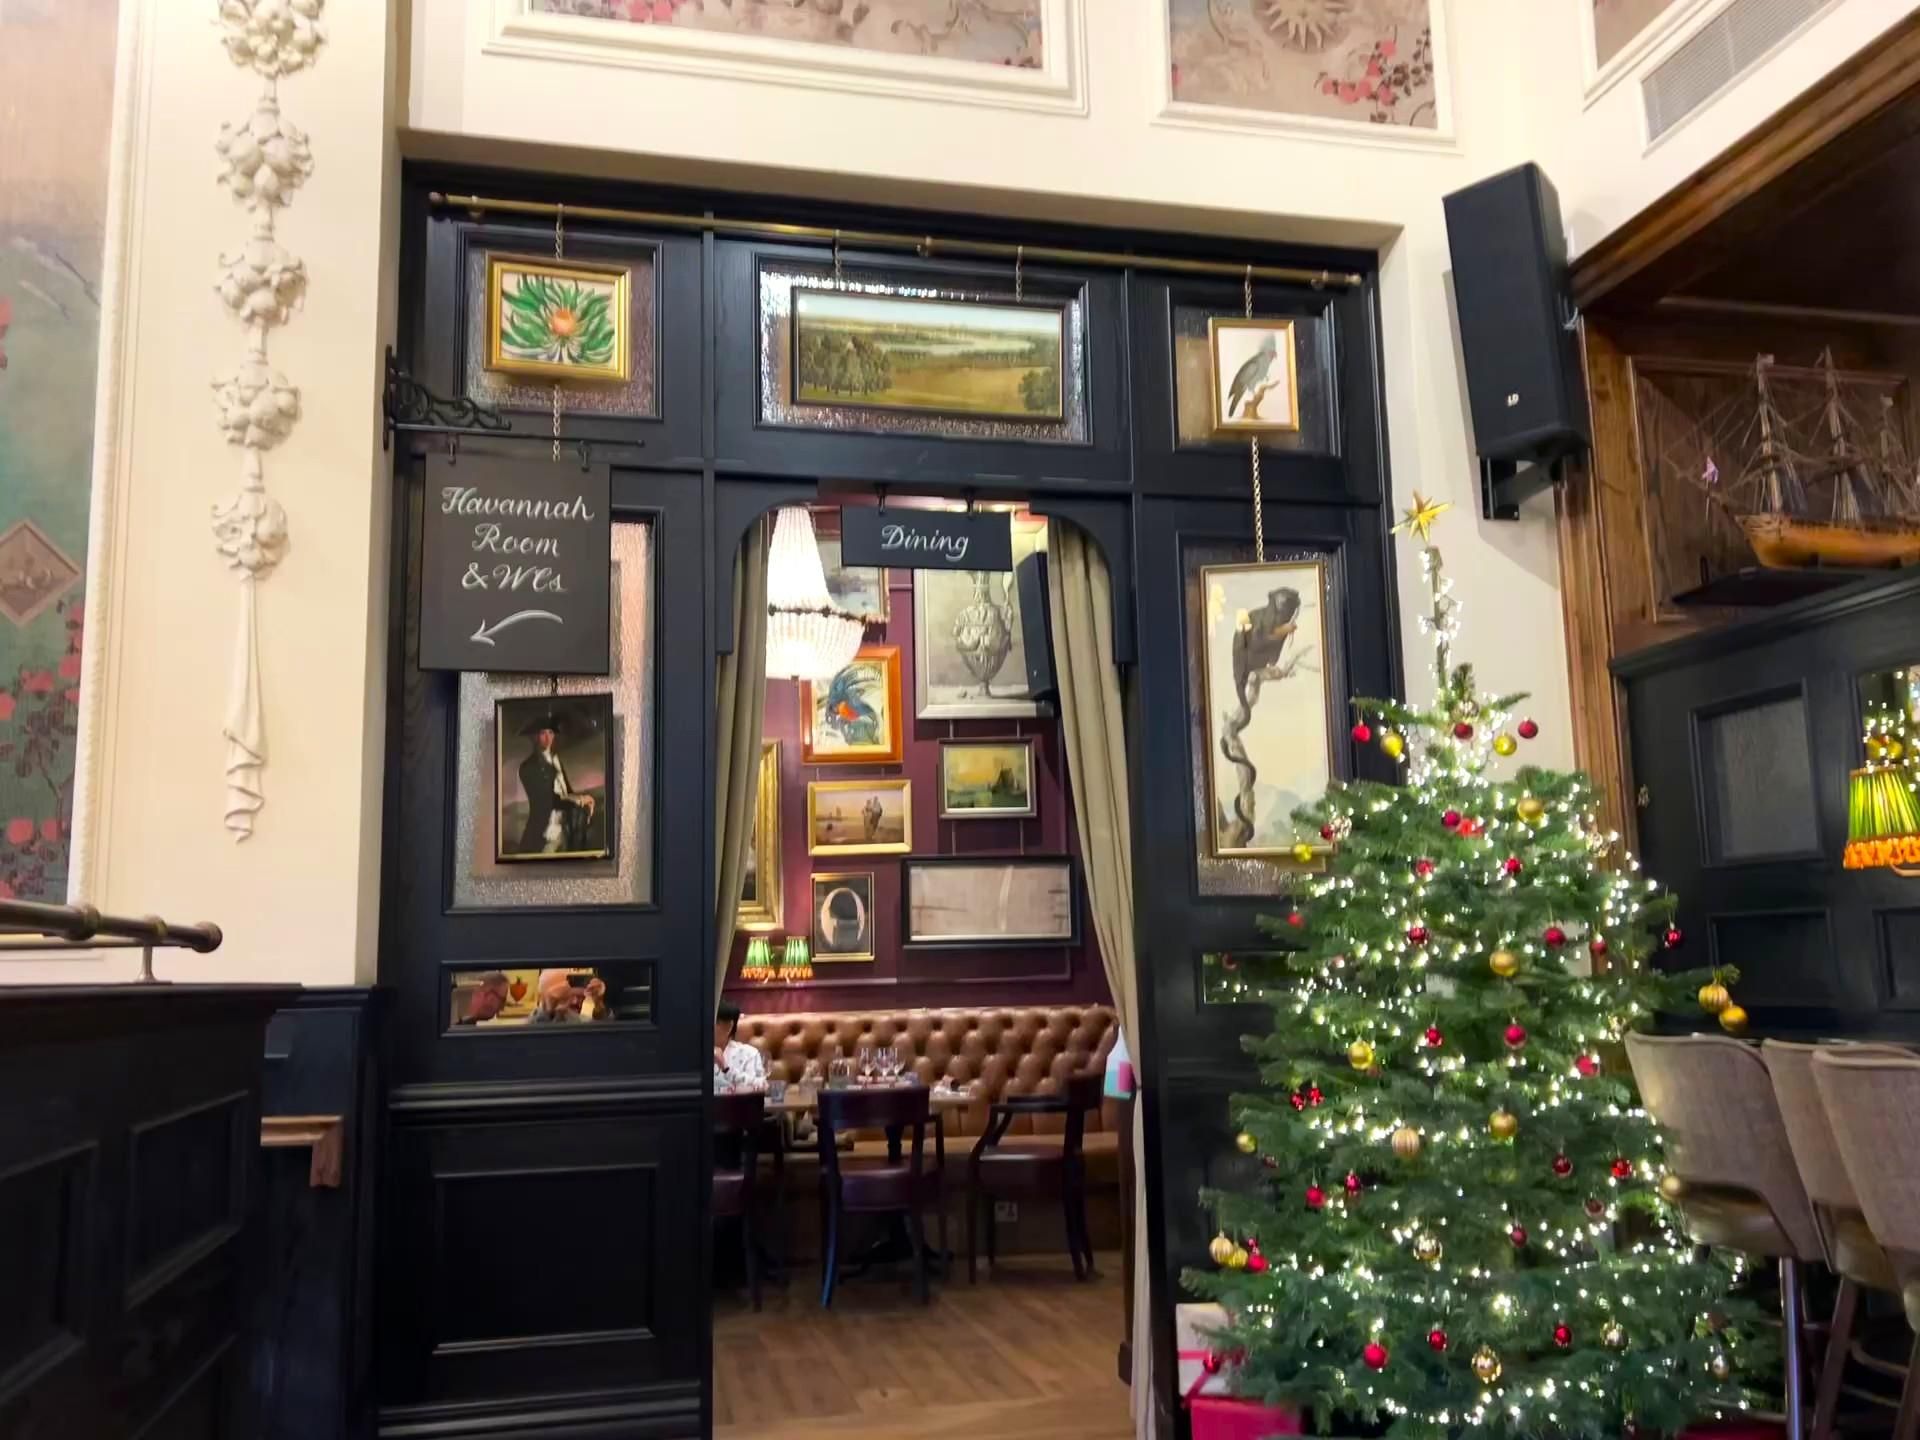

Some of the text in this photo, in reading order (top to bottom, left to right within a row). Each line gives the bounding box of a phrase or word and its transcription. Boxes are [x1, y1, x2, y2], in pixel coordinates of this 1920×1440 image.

[441, 486, 595, 521] Havannah
[472, 523, 560, 557] Room
[881, 524, 969, 562] Dining
[461, 562, 568, 592] & WCs
